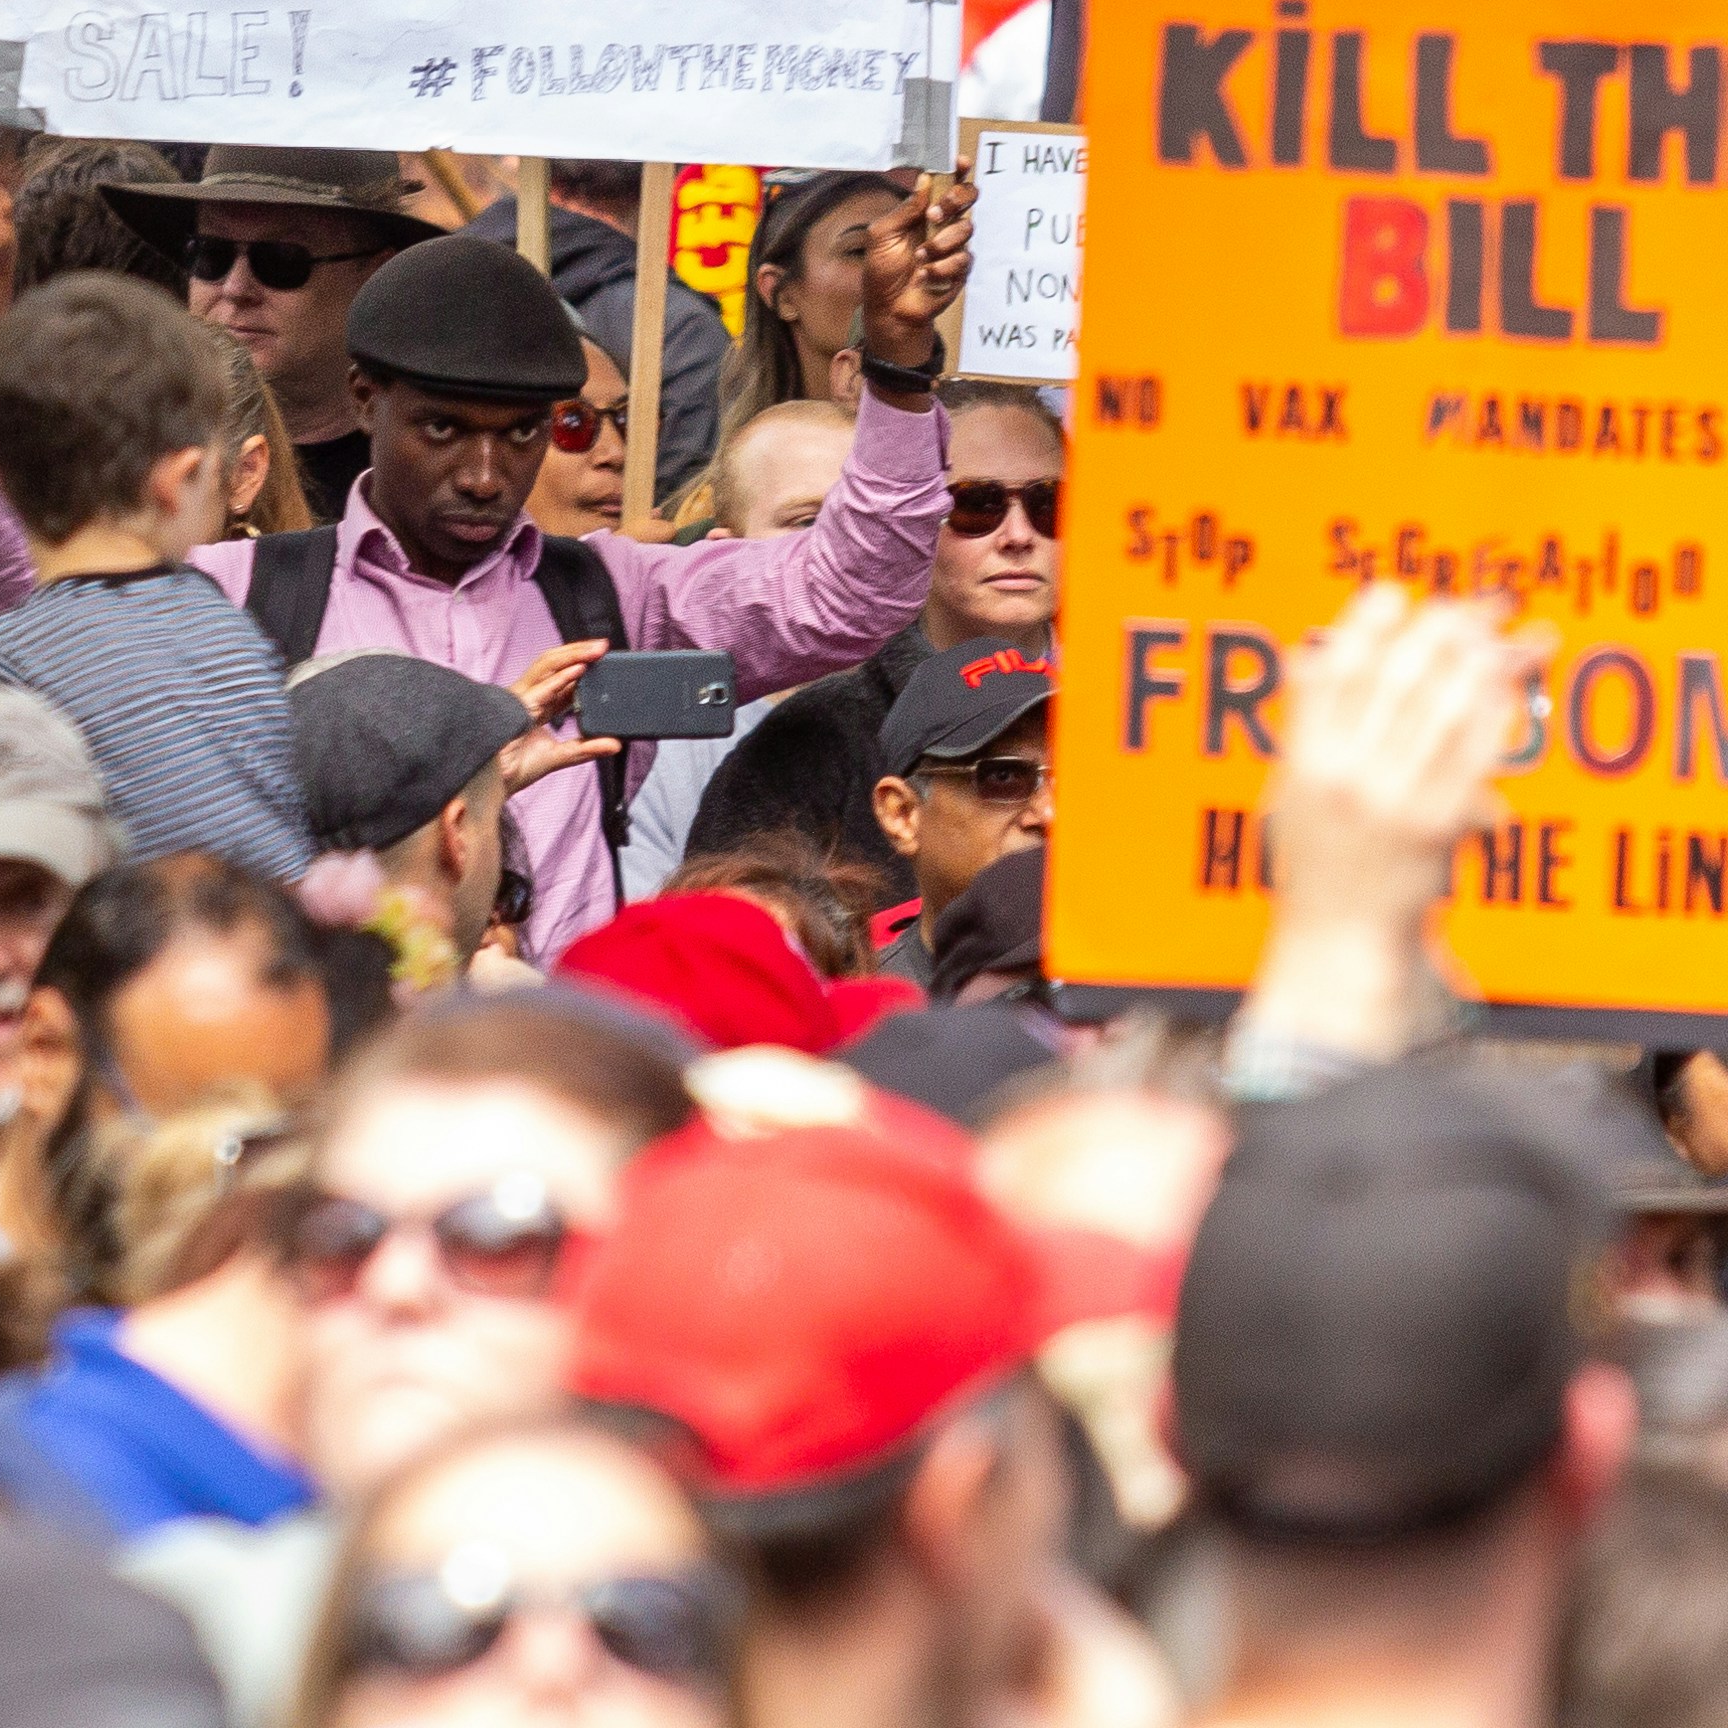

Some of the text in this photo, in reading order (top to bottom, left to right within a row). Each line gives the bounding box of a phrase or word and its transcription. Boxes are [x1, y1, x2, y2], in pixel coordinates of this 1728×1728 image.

[63, 8, 313, 102] SALE!
[983, 140, 1007, 176] I
[1338, 194, 1668, 346] BILL
[978, 323, 1038, 350] WAS
[1092, 376, 1728, 464] NO VAX MANDATES
[958, 647, 1055, 689] FIL
